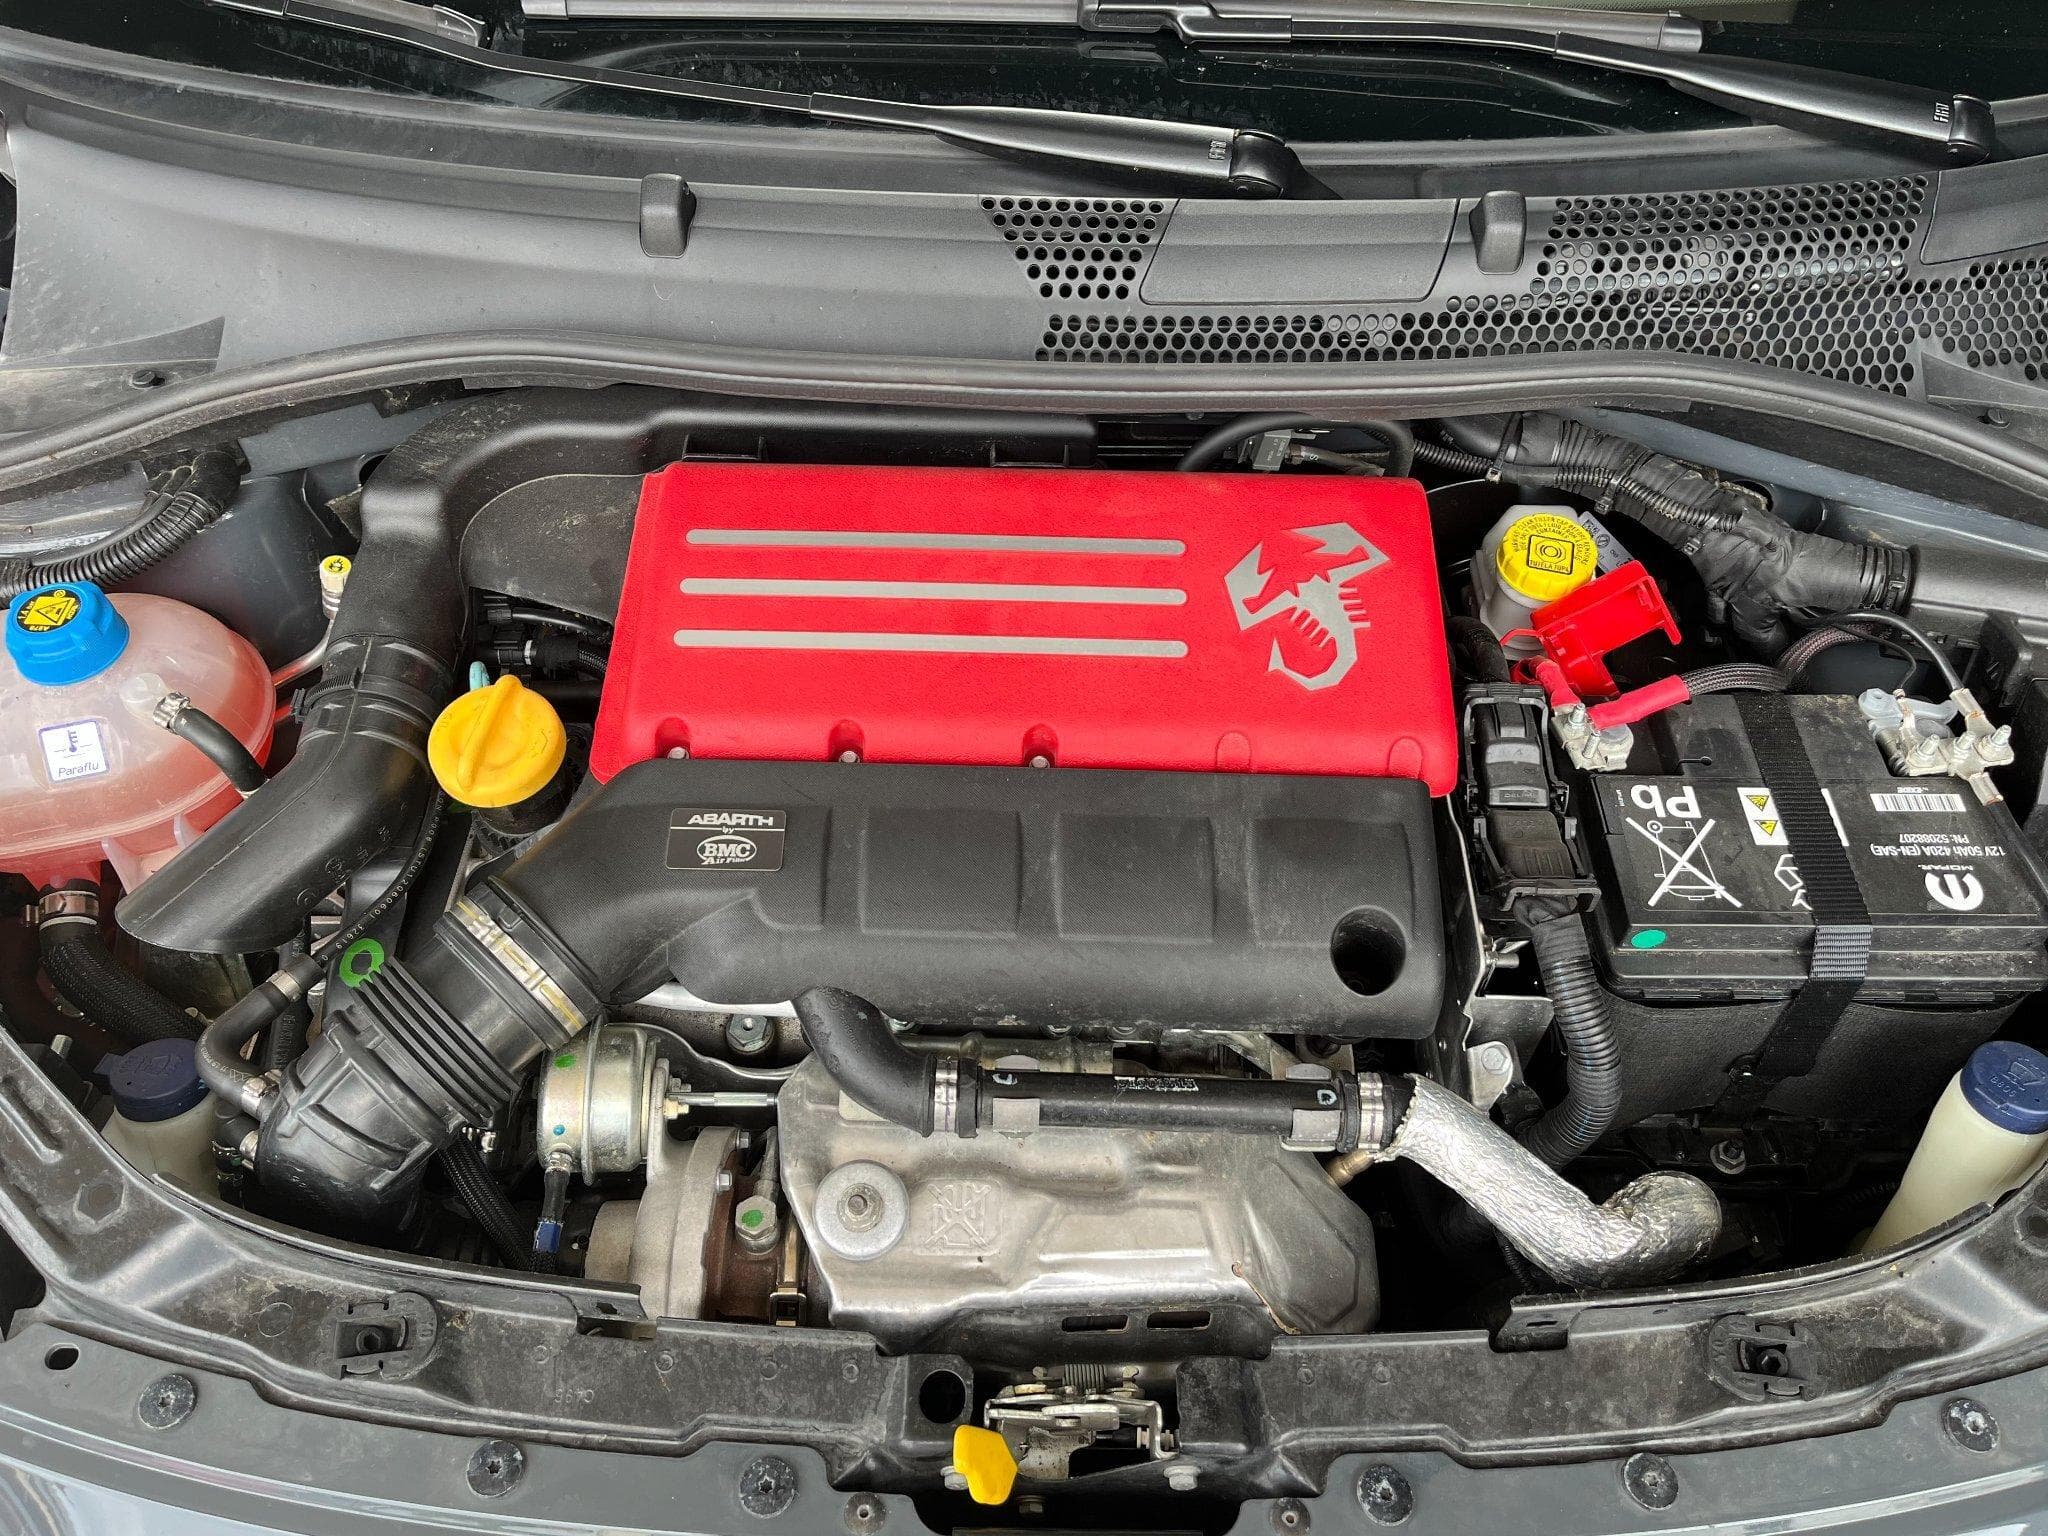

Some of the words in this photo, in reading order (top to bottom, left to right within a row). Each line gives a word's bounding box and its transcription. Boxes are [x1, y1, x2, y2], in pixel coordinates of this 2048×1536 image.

[58, 761, 100, 778] Paraflu
[1630, 784, 1702, 818] Pb
[687, 813, 774, 826] ABARTH
[722, 826, 735, 834] by
[702, 843, 751, 857] BMC
[1869, 843, 1921, 855] (EN-SAE)
[1921, 845, 1951, 856] 420A
[1952, 845, 1983, 856] 50Ah
[1984, 846, 2006, 857] 12V
